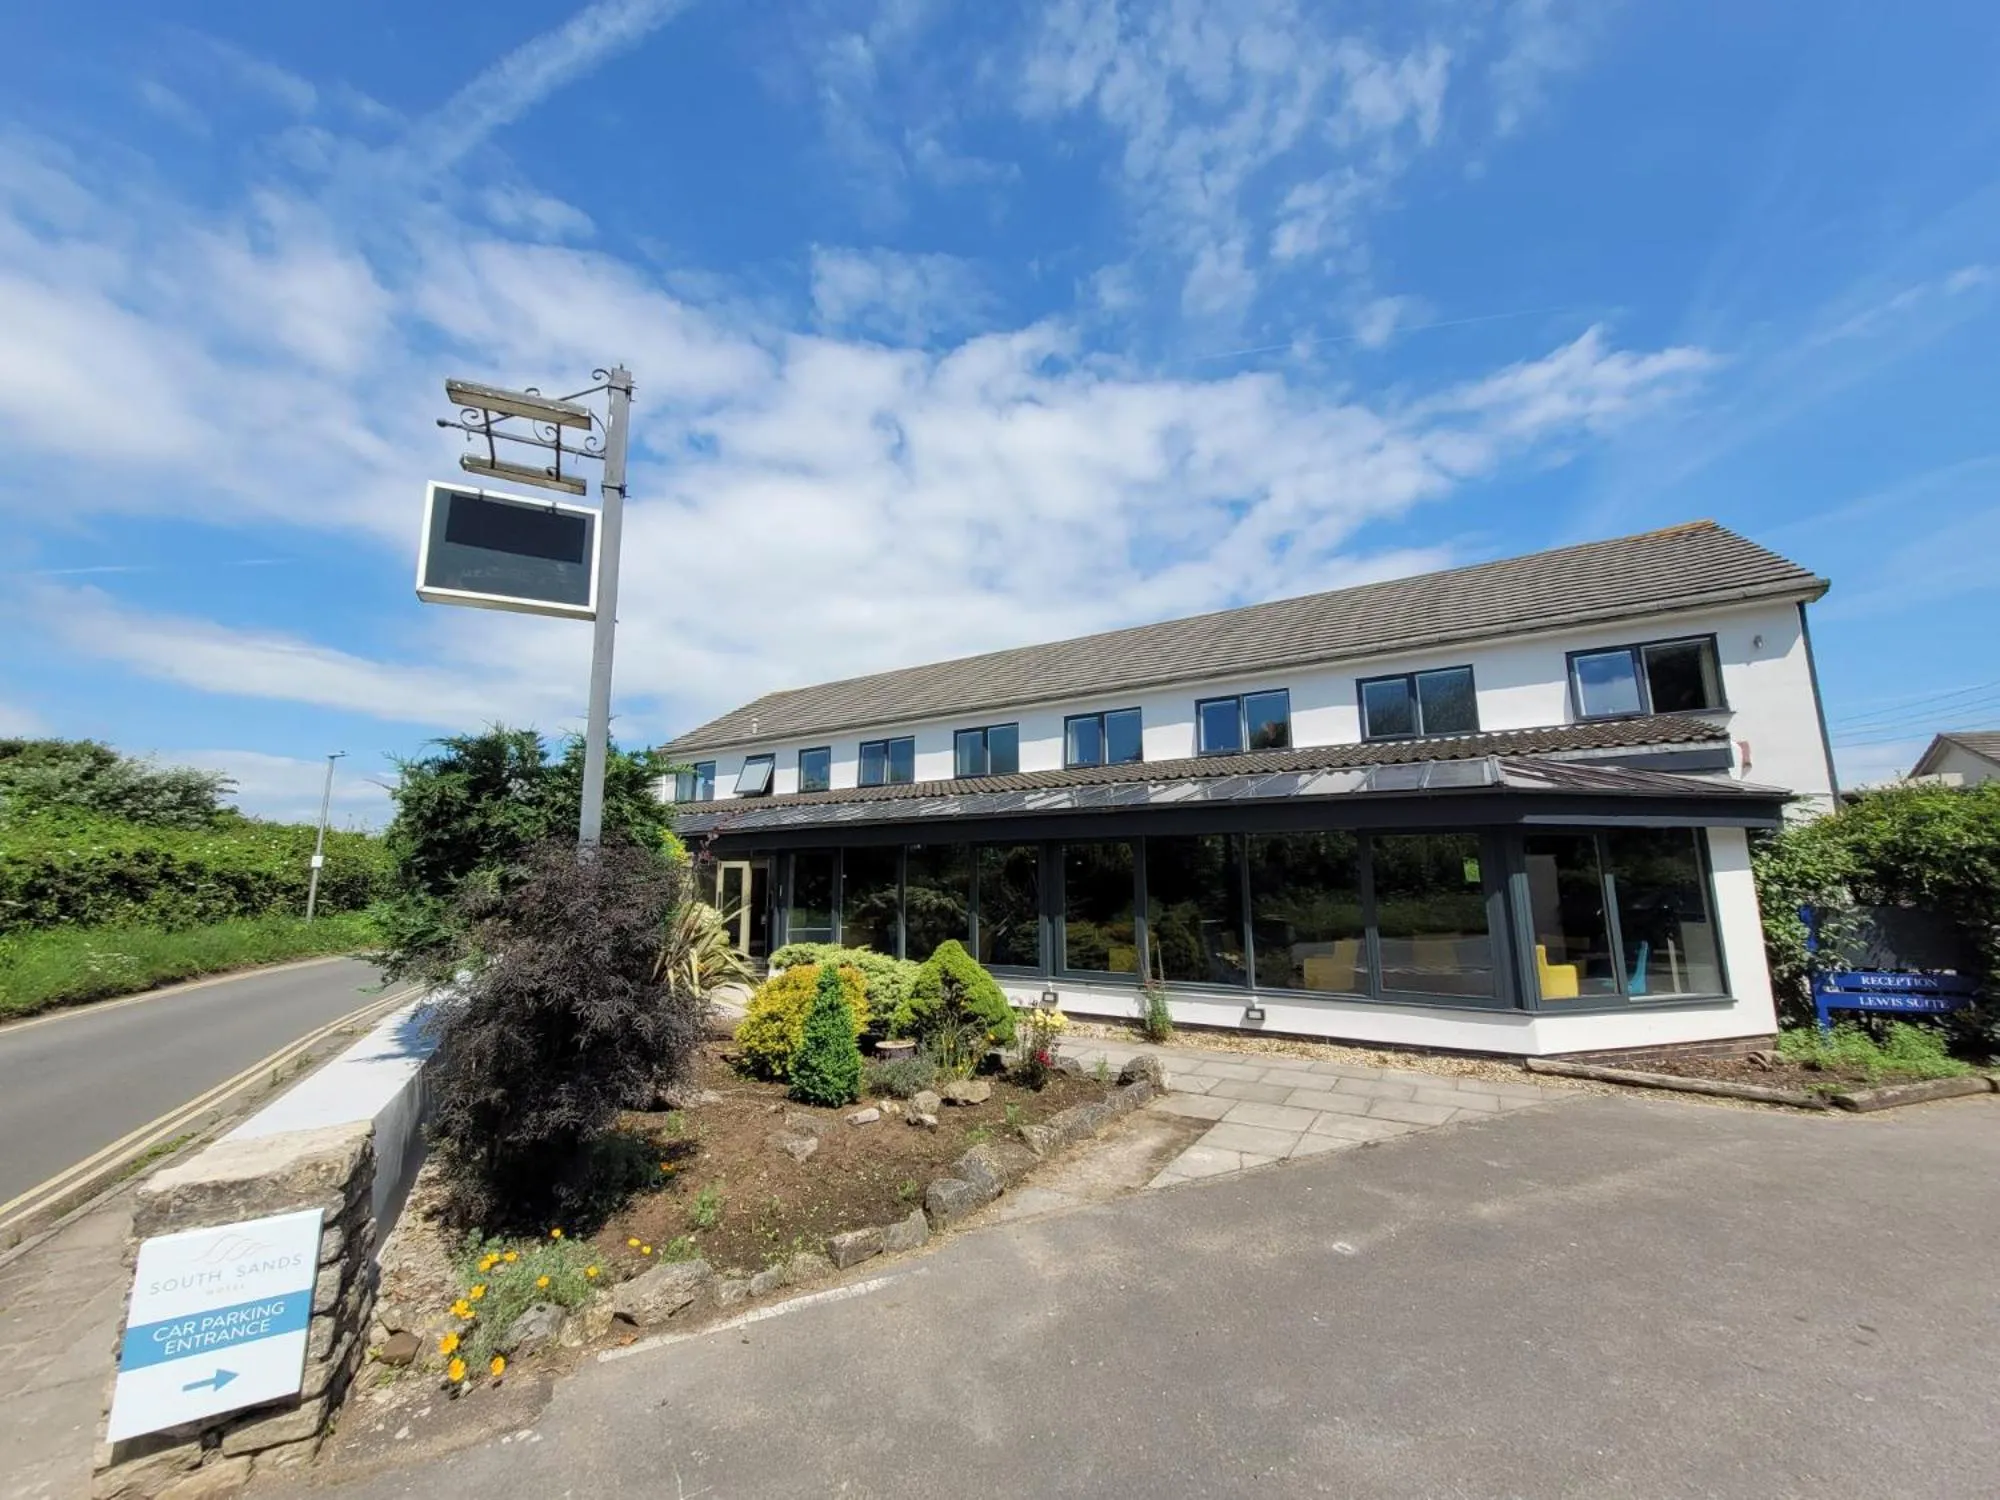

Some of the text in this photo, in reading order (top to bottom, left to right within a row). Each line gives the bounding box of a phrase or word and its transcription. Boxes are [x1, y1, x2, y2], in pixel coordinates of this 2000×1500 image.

[1860, 976, 1939, 987] RECEPTION
[1859, 996, 1950, 1009] LEWIS SUITE
[151, 1253, 302, 1295] SOUTH SANDS
[153, 1302, 285, 1343] CAR PARKING
[164, 1319, 271, 1354] ENTRANCE
